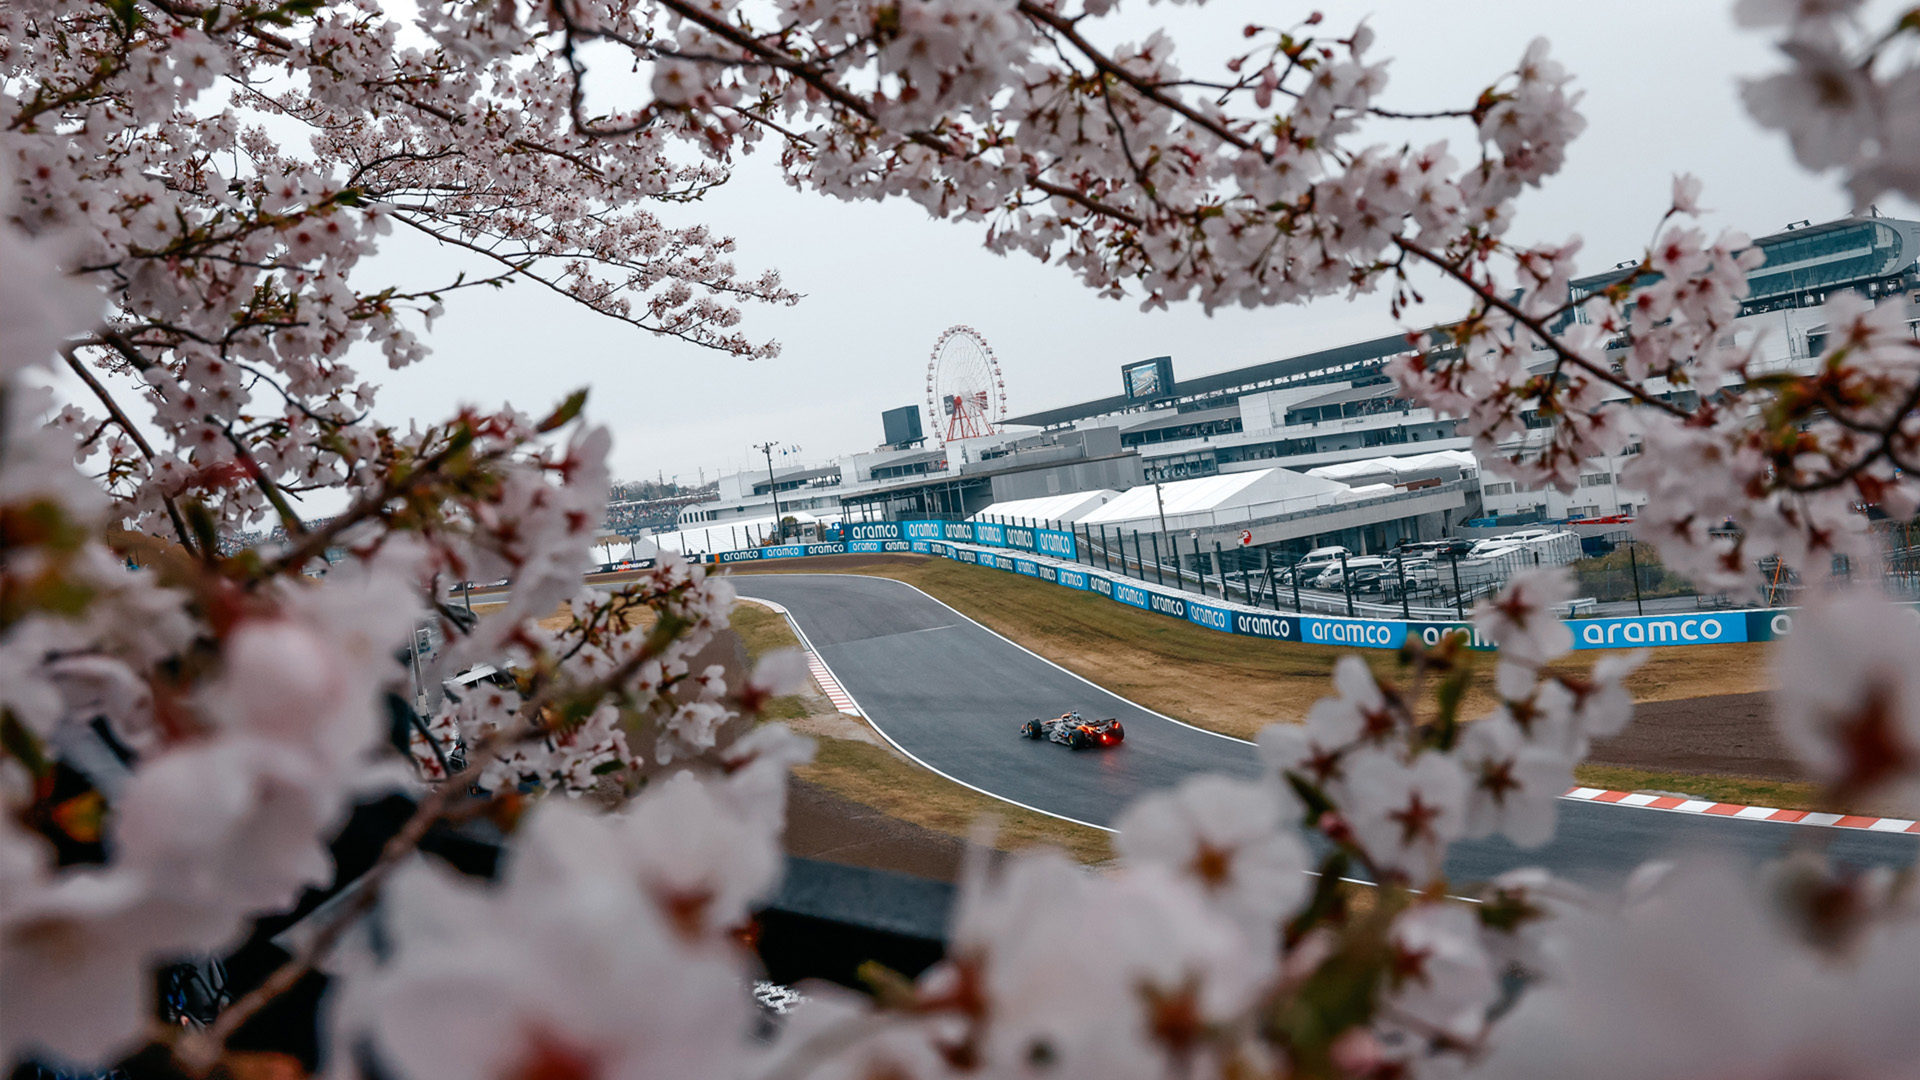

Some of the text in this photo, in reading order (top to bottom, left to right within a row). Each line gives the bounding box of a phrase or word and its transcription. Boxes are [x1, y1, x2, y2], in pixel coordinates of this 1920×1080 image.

[852, 524, 898, 539] aramco
[908, 523, 939, 538] aramco
[945, 523, 972, 539] aramco
[978, 525, 1001, 543] aramco
[1007, 528, 1033, 548] aramco
[767, 546, 799, 557] aramco
[808, 543, 844, 554] aramco
[852, 542, 878, 551] aramco
[885, 541, 909, 551] aramco
[1040, 533, 1071, 554] aramco
[723, 551, 759, 561] aramco
[1060, 570, 1083, 587] aramco
[1090, 577, 1112, 596] aramco
[1117, 585, 1144, 606] aramco
[1151, 595, 1184, 616] aramco
[1190, 605, 1225, 628] aramco
[1238, 615, 1290, 638] aramco
[1311, 621, 1391, 645] aramco
[1583, 618, 1722, 644] aramco
[1423, 627, 1500, 647] aram
